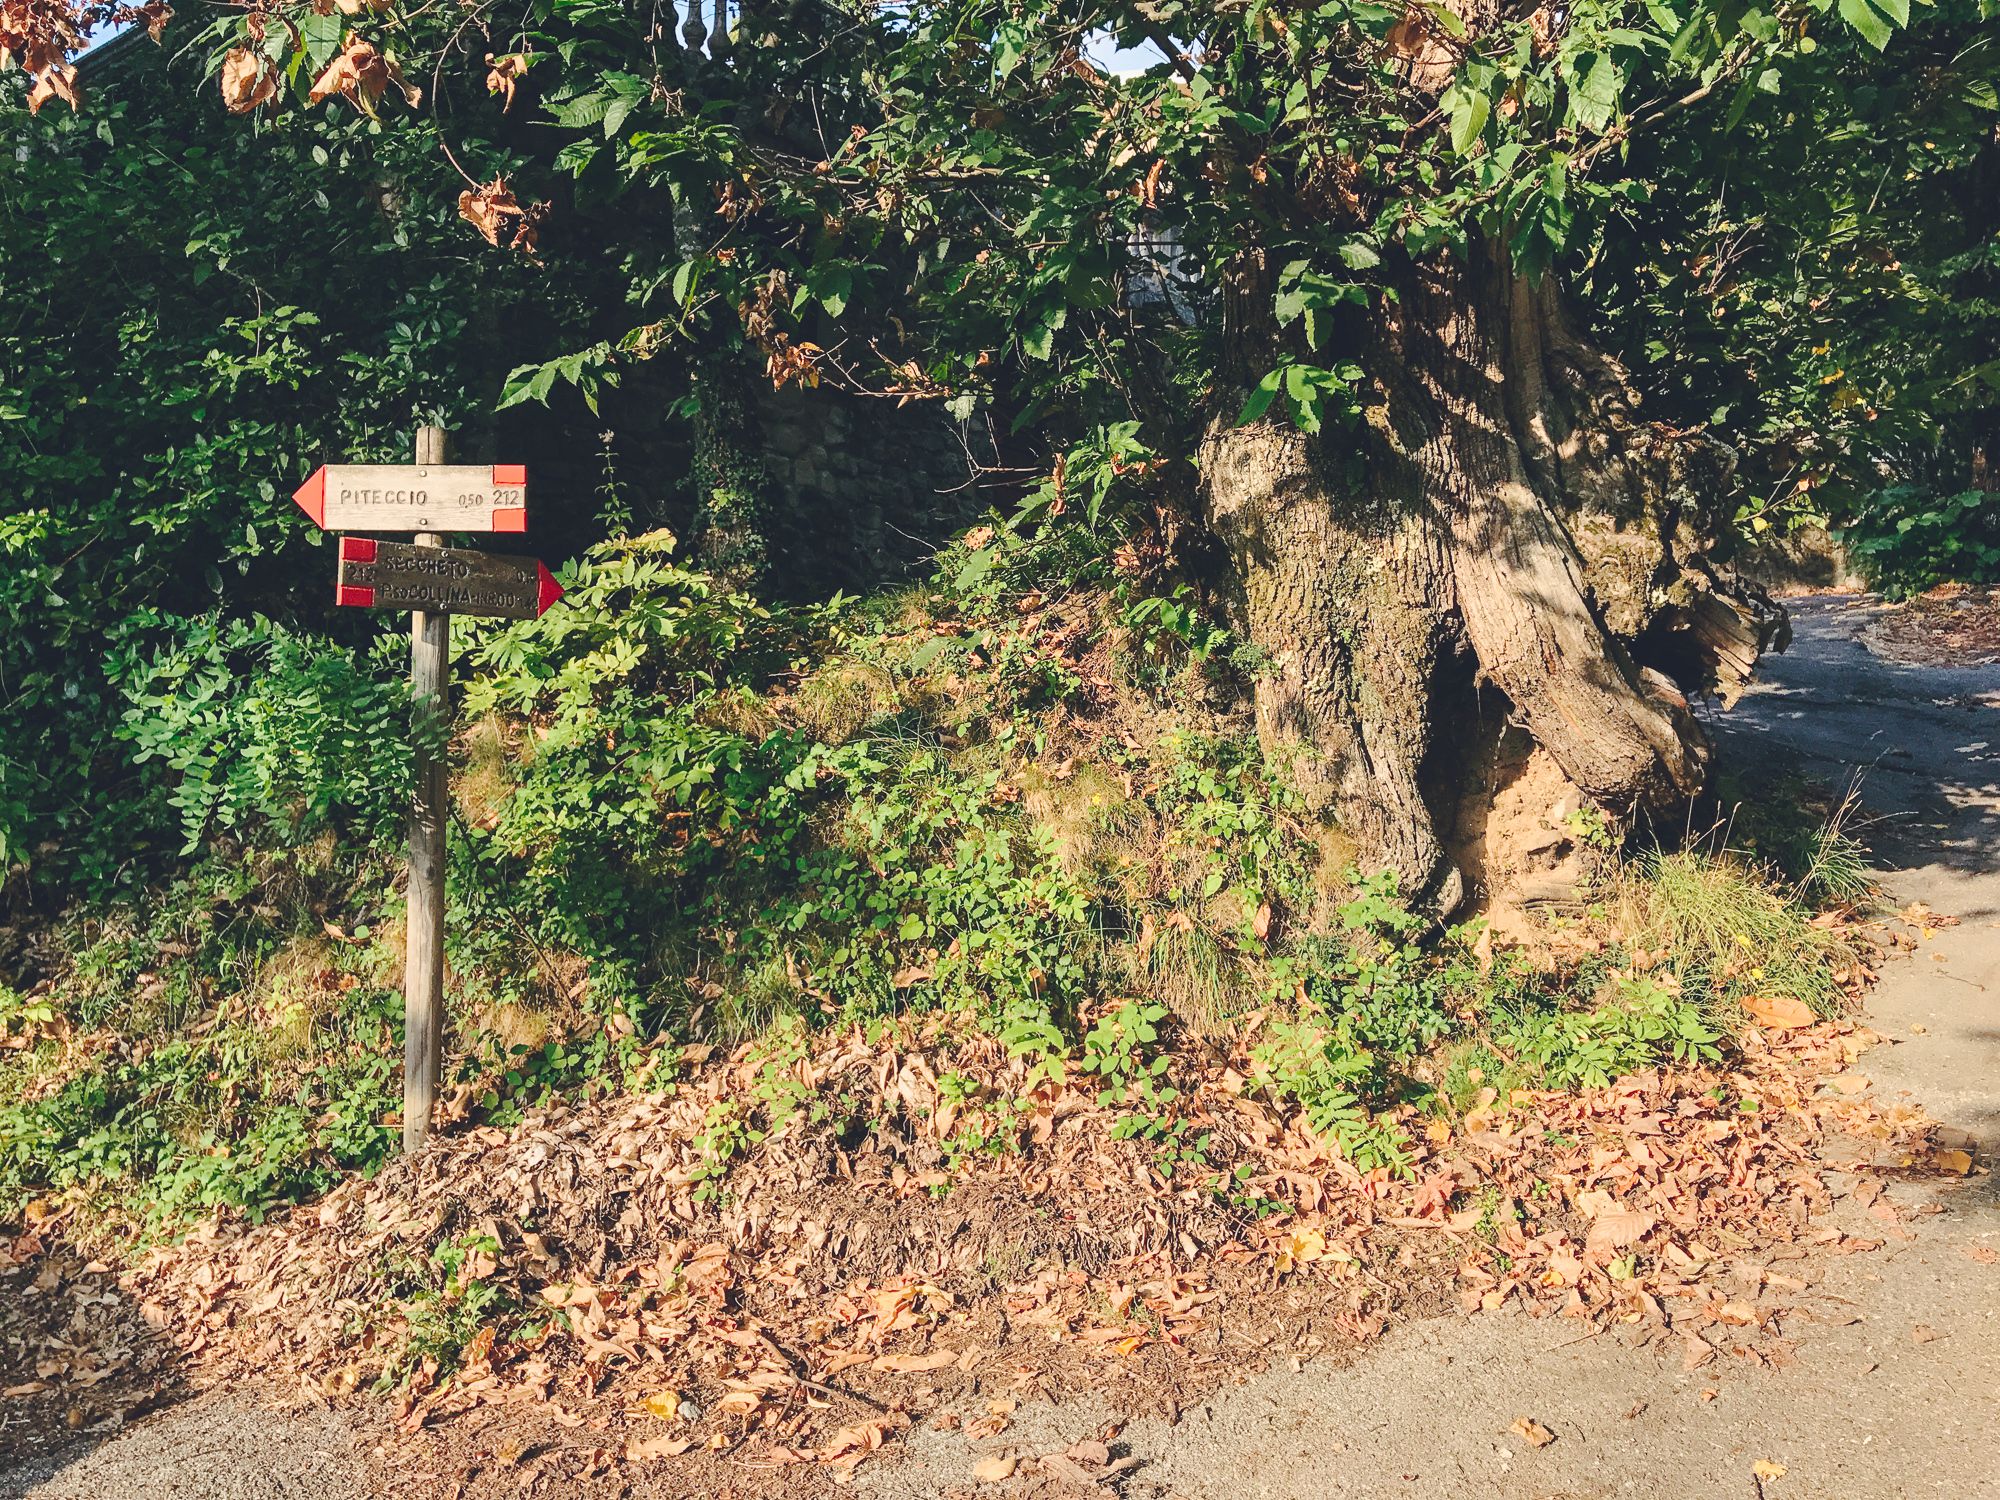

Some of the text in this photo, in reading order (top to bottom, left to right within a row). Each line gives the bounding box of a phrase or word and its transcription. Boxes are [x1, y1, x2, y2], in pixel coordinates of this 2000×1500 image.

[341, 489, 428, 505] PITECCIO
[493, 489, 520, 505] 212
[347, 564, 376, 583] 212
